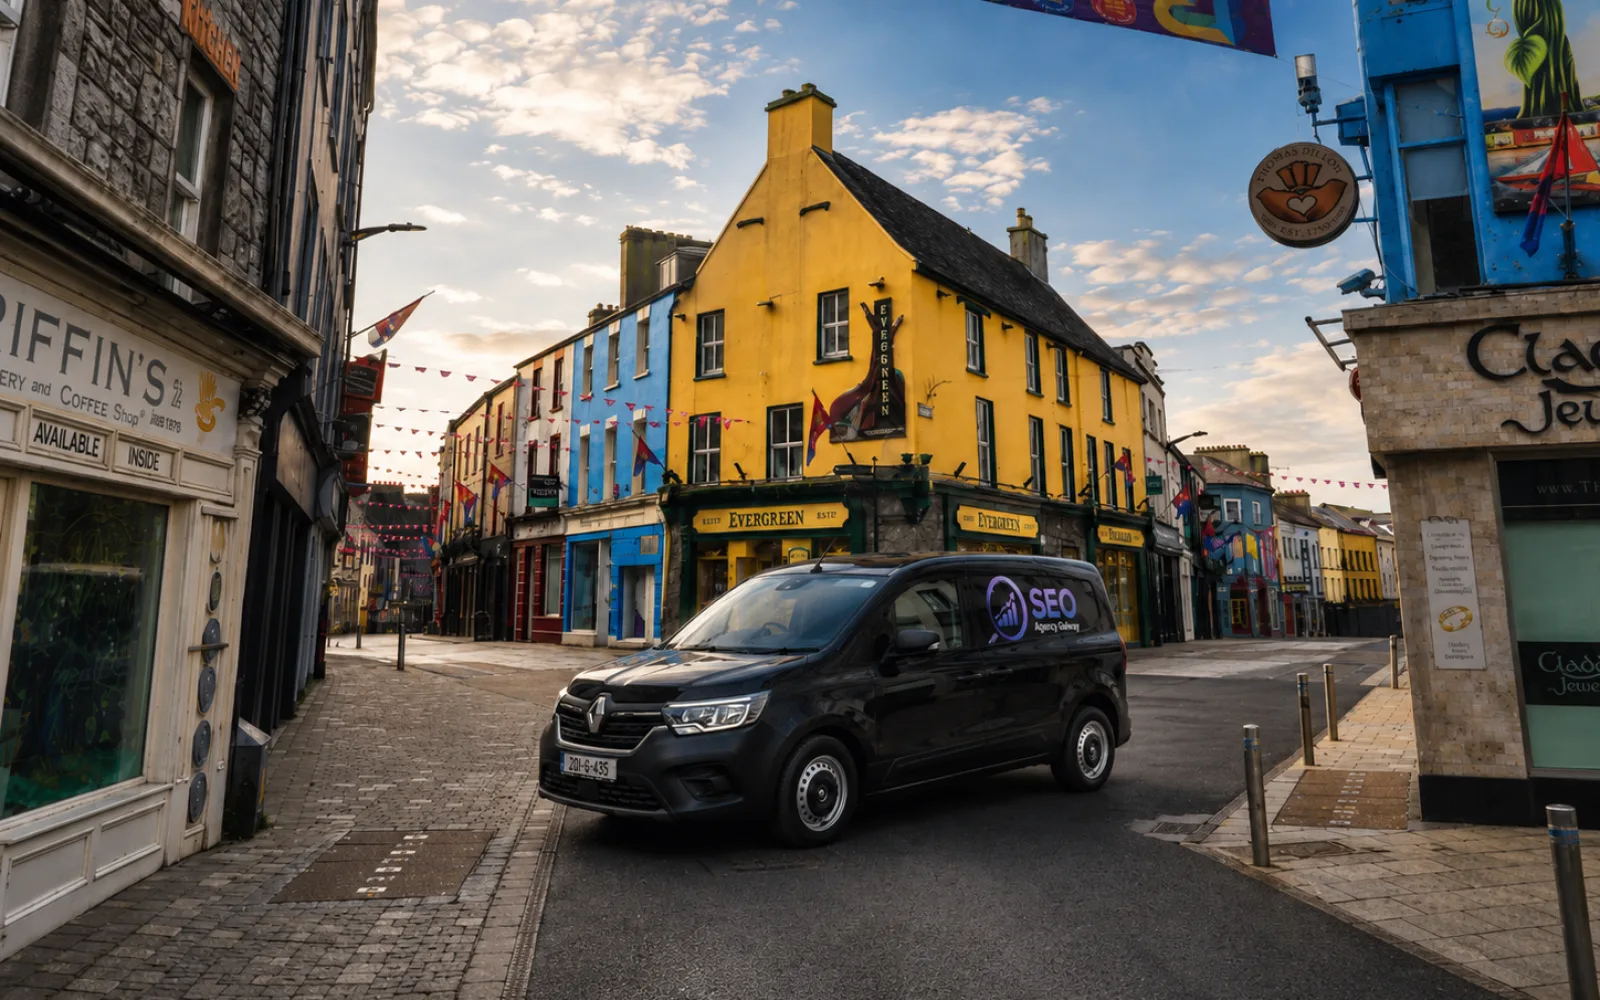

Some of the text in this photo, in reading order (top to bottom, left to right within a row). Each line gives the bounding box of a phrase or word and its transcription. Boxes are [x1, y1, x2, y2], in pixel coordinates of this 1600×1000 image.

[1257, 147, 1342, 182] THOMAS DILLON
[31, 380, 52, 396] and
[33, 421, 100, 457] AVAILABLE
[128, 446, 160, 471] INSIDE
[1029, 587, 1077, 619] SEO
[1538, 651, 1600, 679] Clad
